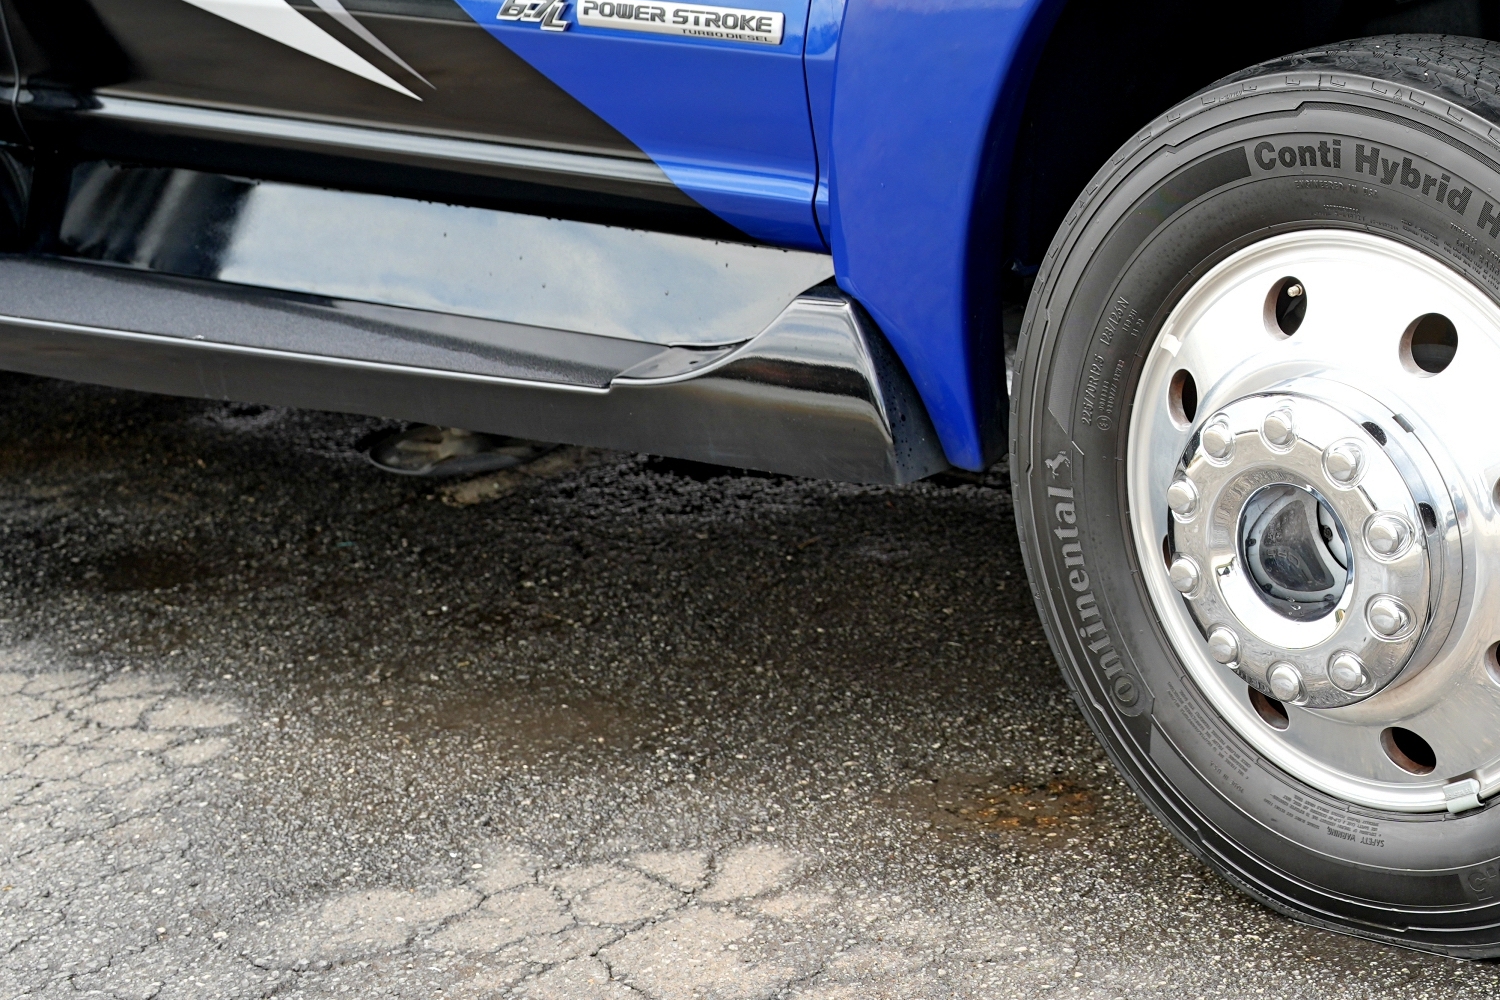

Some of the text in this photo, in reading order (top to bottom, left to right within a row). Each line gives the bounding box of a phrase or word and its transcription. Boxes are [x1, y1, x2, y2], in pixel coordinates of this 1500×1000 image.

[582, 0, 667, 24] POWER
[672, 8, 774, 34] STROKE
[681, 28, 774, 43] TURBO DIESEL
[1253, 138, 1342, 171] Conti
[1354, 143, 1474, 217] Hybrid
[1045, 485, 1146, 718] Continental
[1359, 836, 1385, 848] SAFETY
